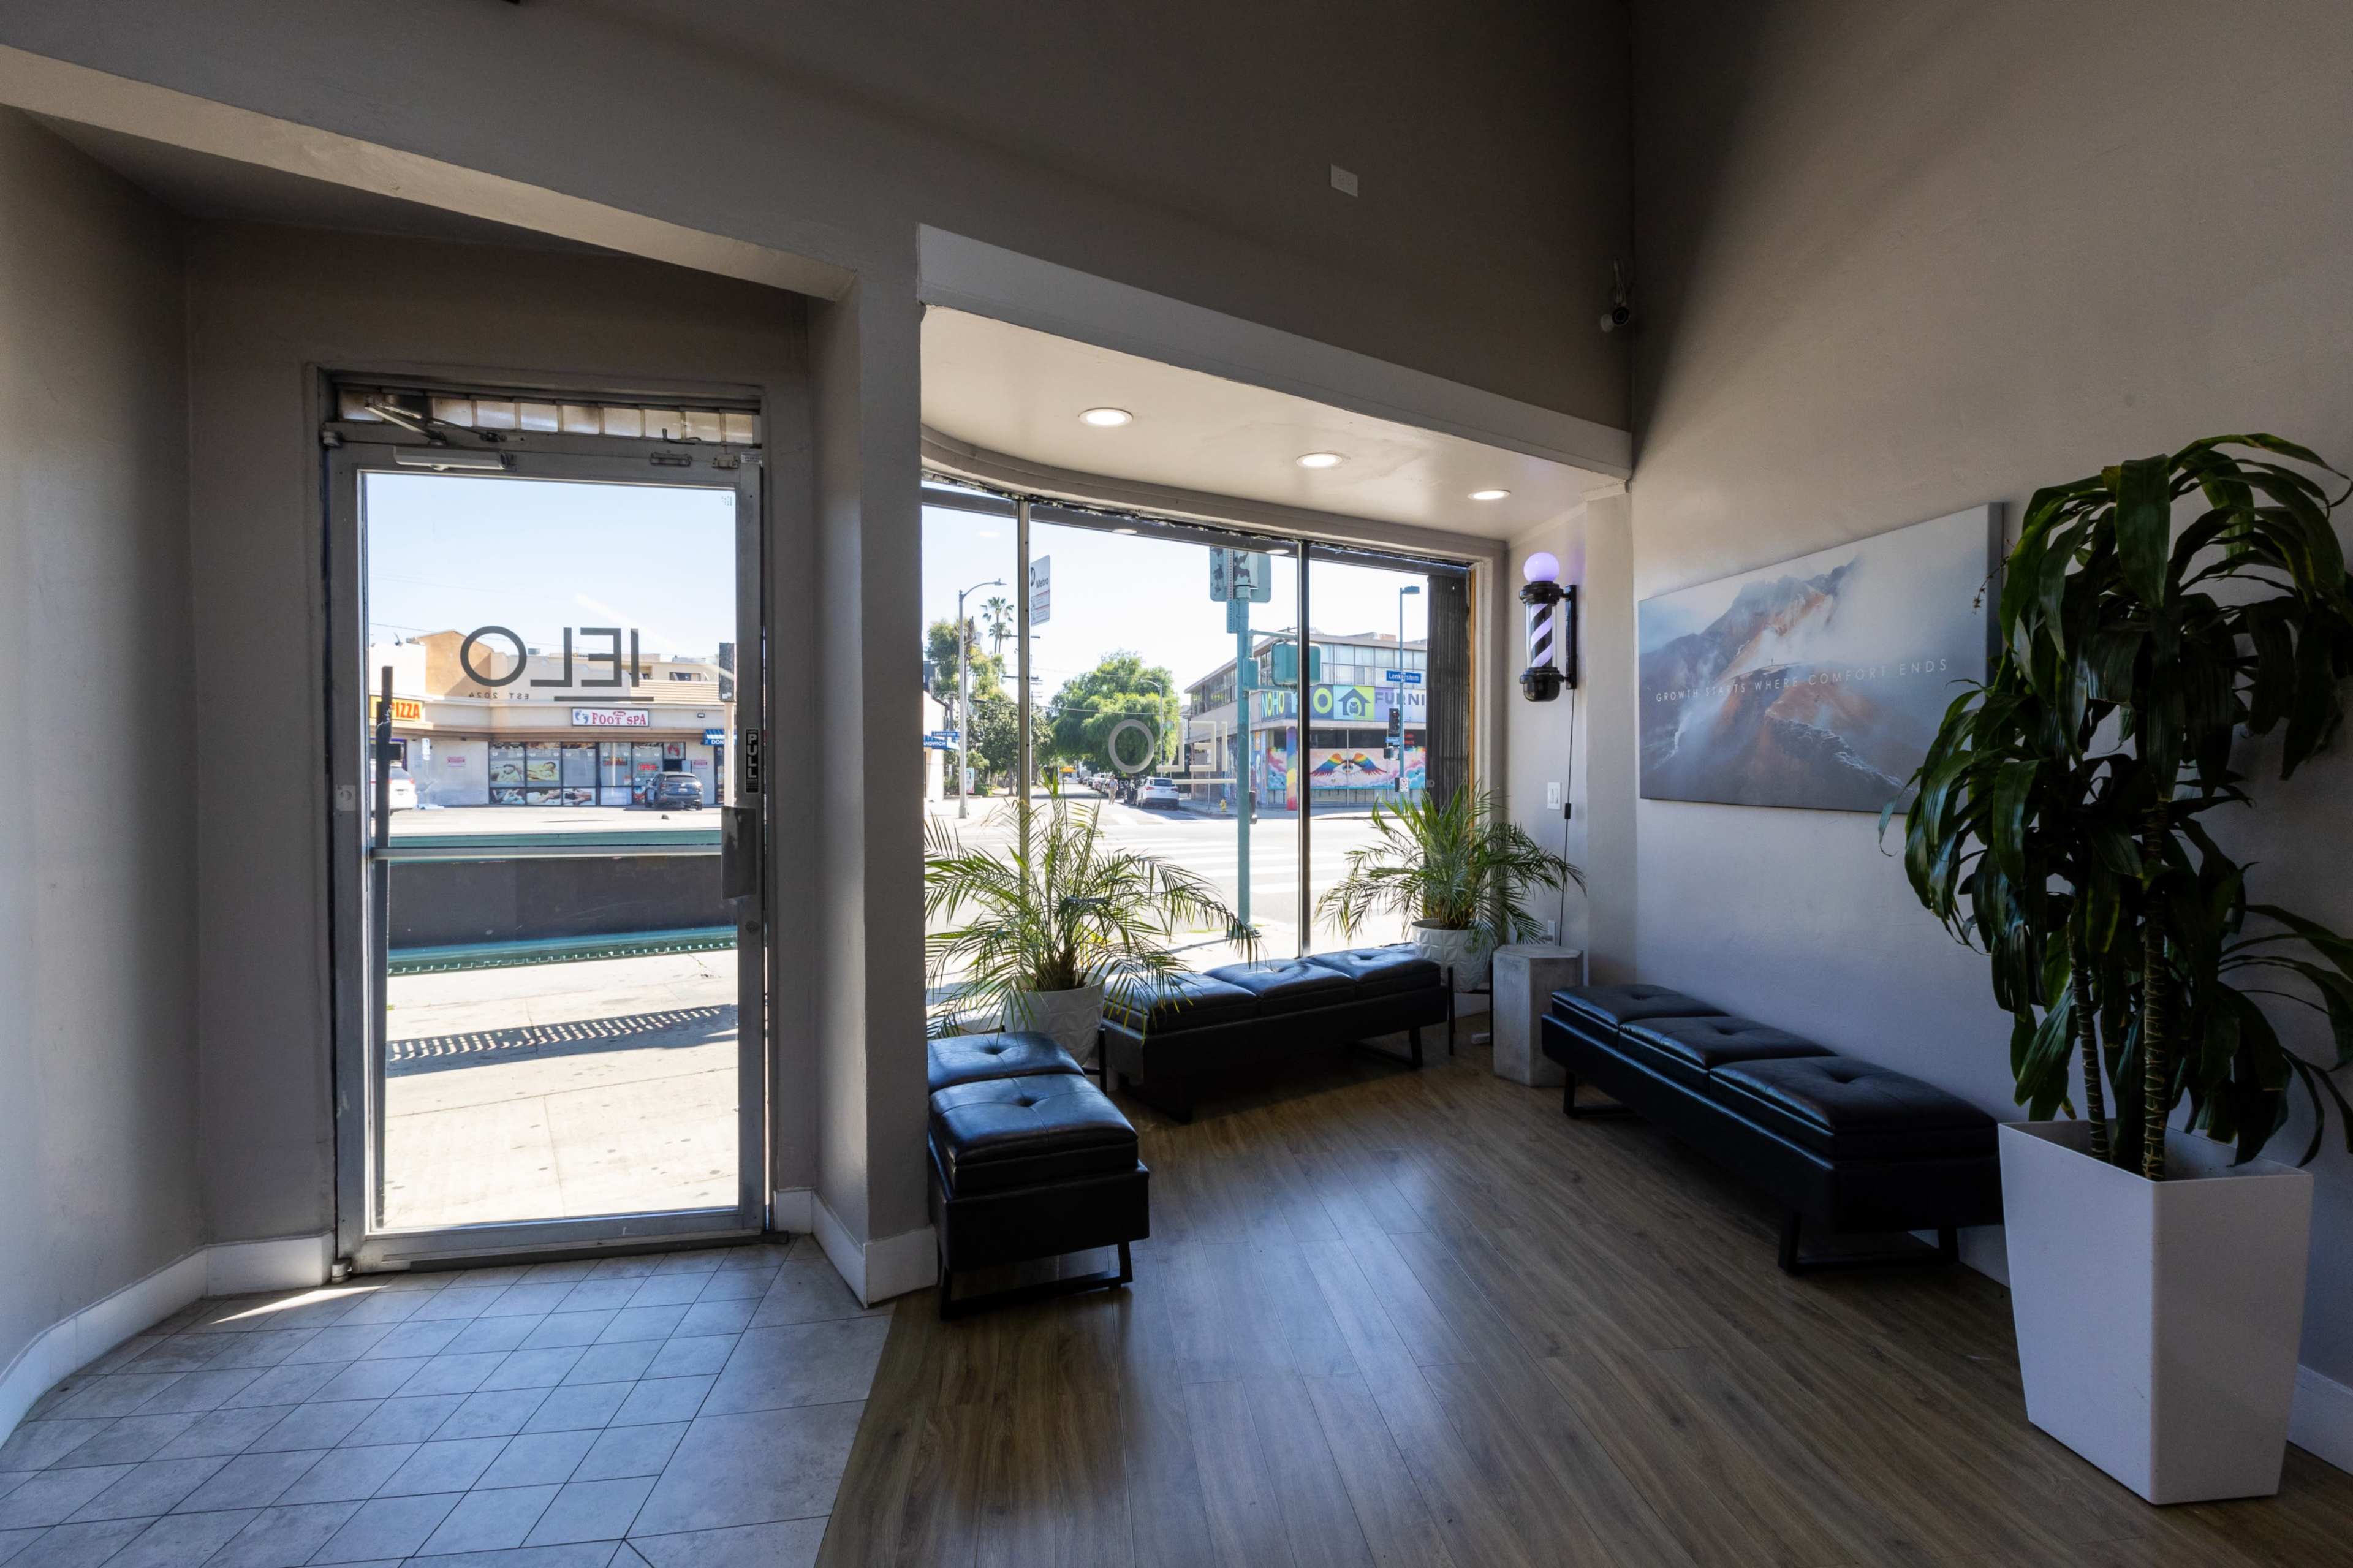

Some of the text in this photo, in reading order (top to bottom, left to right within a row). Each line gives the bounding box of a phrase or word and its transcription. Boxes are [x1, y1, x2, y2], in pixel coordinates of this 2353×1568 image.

[1036, 578, 1049, 589] Metro
[1656, 659, 1947, 702] GROWTH STARTS WHERE COMFORT ENDS
[1262, 692, 1284, 717] NOHO
[592, 712, 621, 725] FOOT
[627, 714, 646, 725] SPA
[747, 734, 758, 778] PULL
